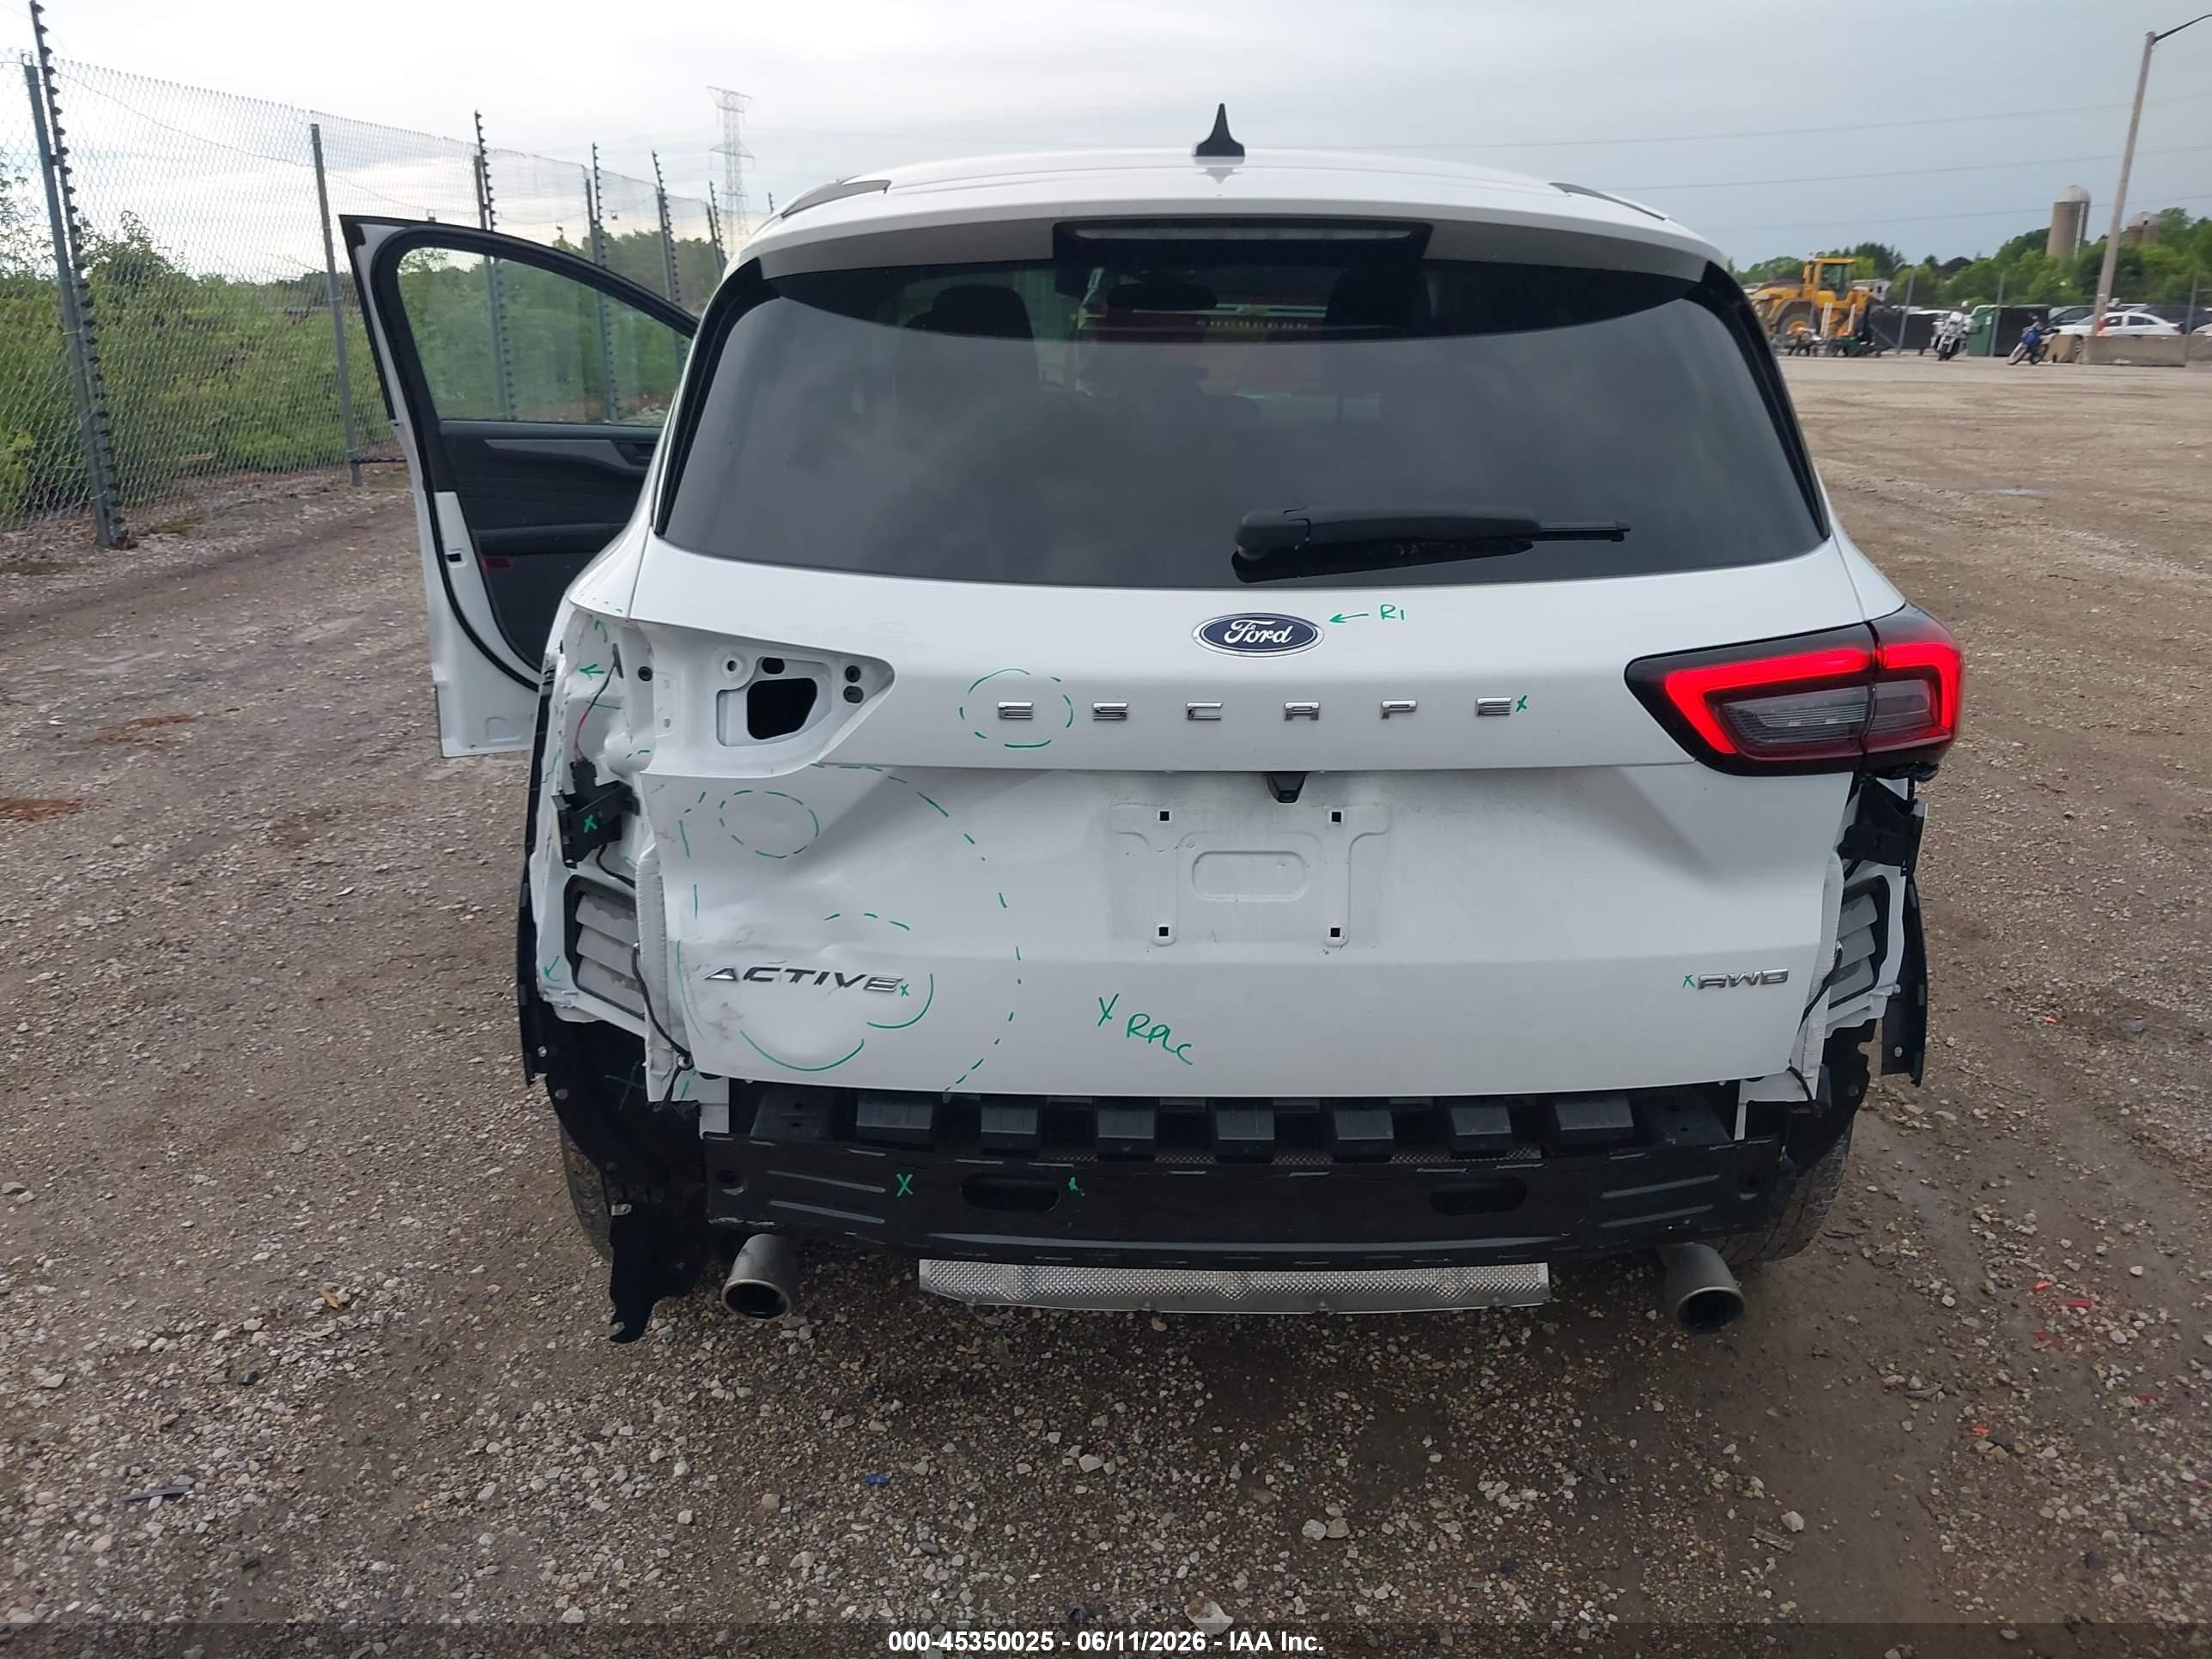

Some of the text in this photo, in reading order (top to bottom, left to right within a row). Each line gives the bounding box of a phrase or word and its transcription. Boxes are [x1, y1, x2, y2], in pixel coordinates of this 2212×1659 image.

[1224, 618, 1293, 644] Ford
[998, 696, 1511, 721] ESCAPE
[702, 964, 903, 993] ACTIVE
[1697, 968, 1789, 989] AWD
